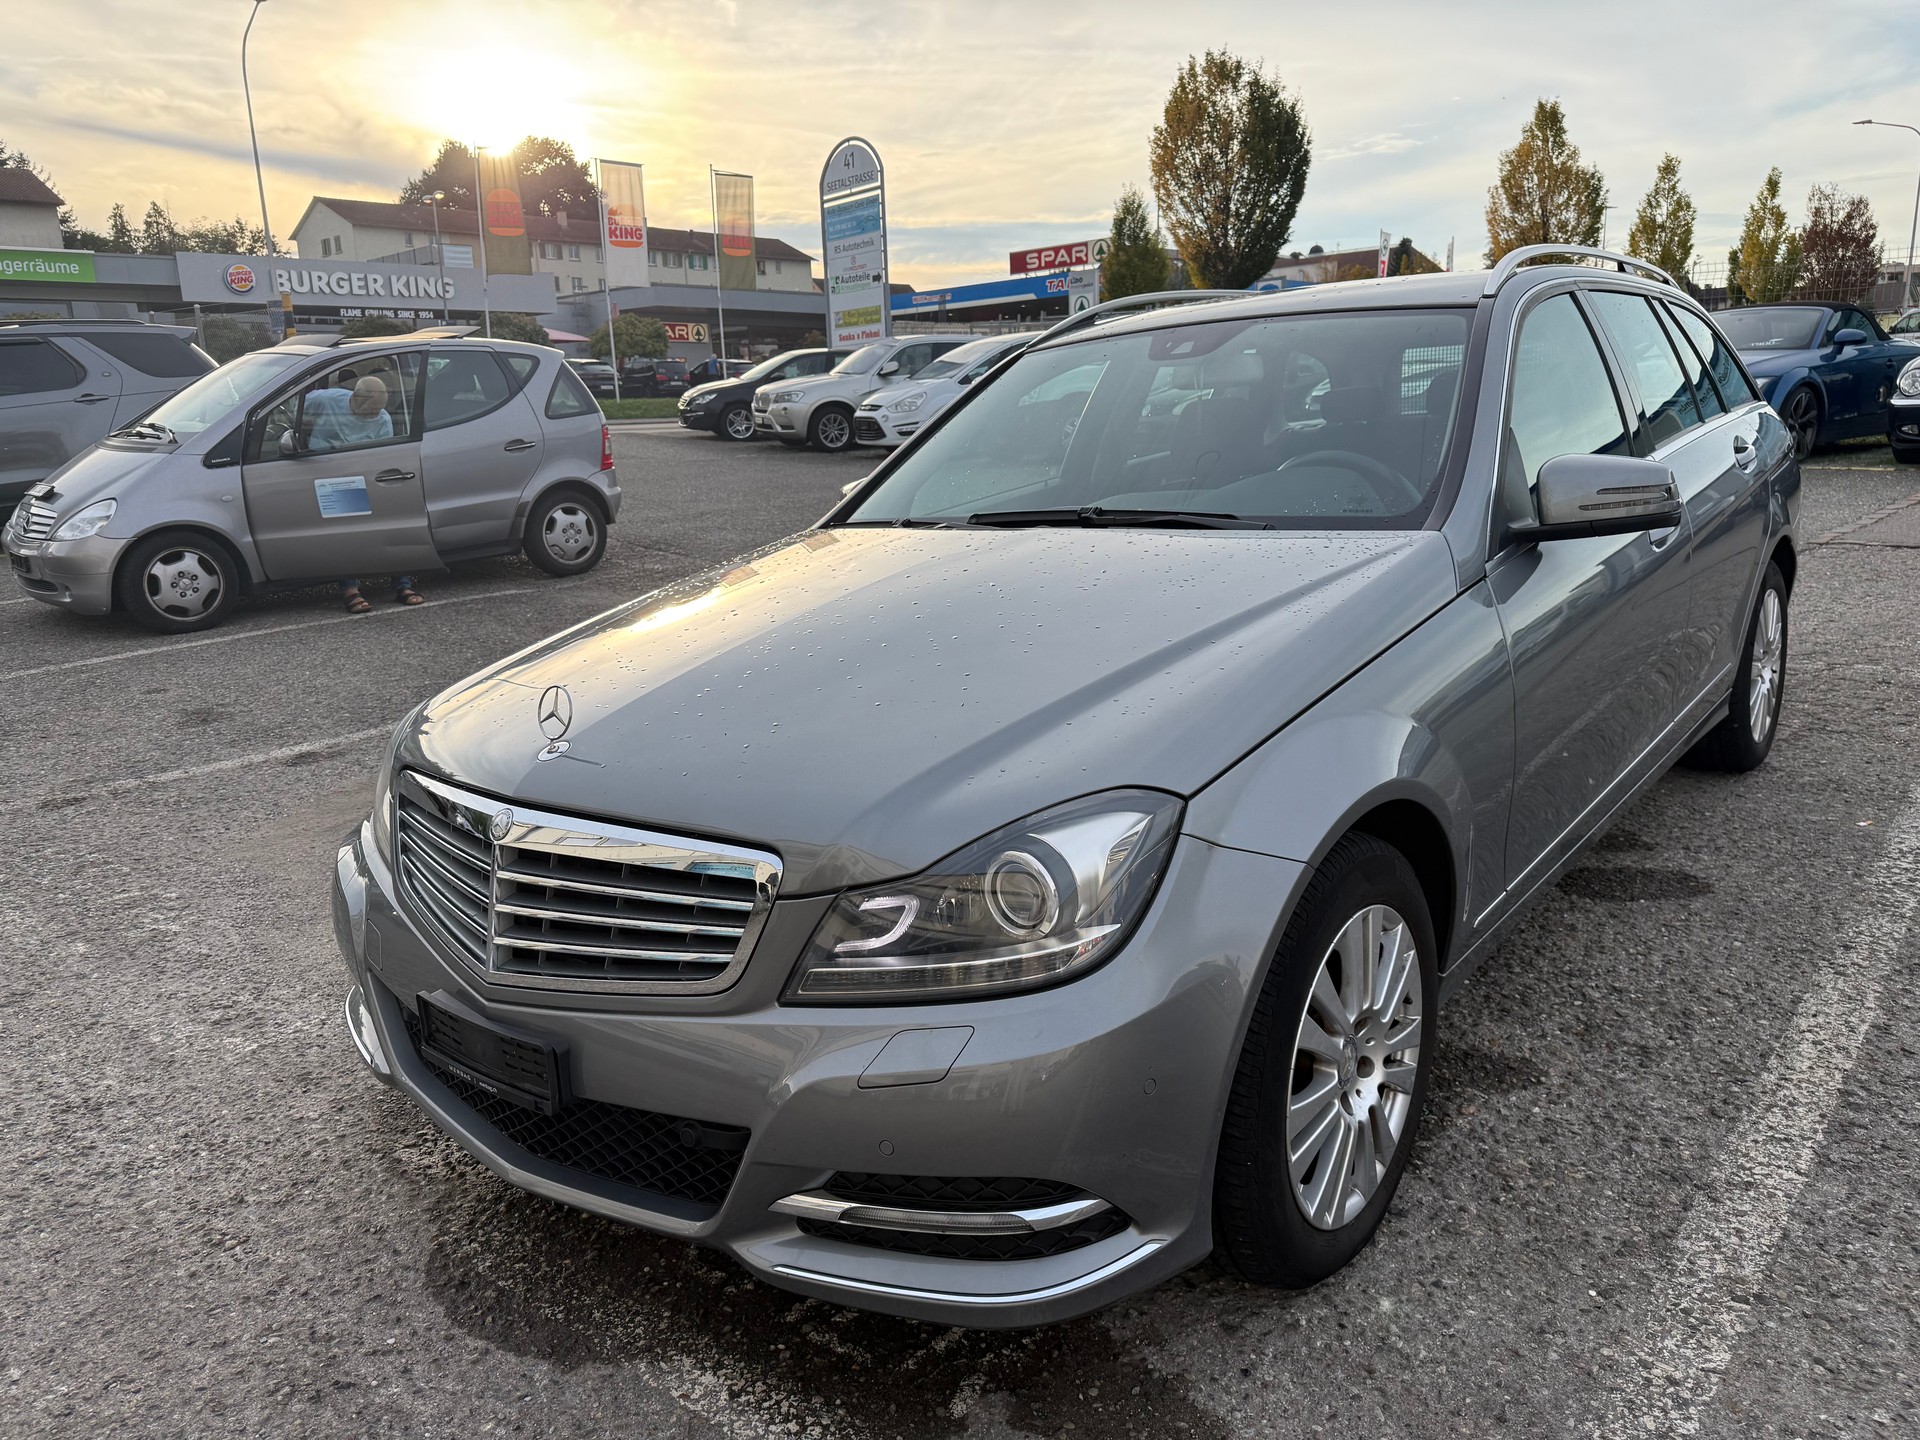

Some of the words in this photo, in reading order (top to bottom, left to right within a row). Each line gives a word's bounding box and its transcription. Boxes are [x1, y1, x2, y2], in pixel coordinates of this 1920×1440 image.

[843, 151, 855, 170] 41
[827, 169, 875, 192] SEETALSTRASSE
[608, 226, 643, 241] KING
[1026, 246, 1087, 269] SPAR
[0, 258, 80, 275] gerräume
[229, 270, 252, 278] BURGER
[230, 275, 253, 285] KING
[275, 269, 386, 297] BURGER
[390, 274, 455, 299] KING
[841, 271, 871, 284] Autoteile
[340, 308, 362, 317] FLAME
[397, 310, 416, 319] SINCE
[418, 311, 434, 319] 1954
[665, 325, 688, 339] AR
